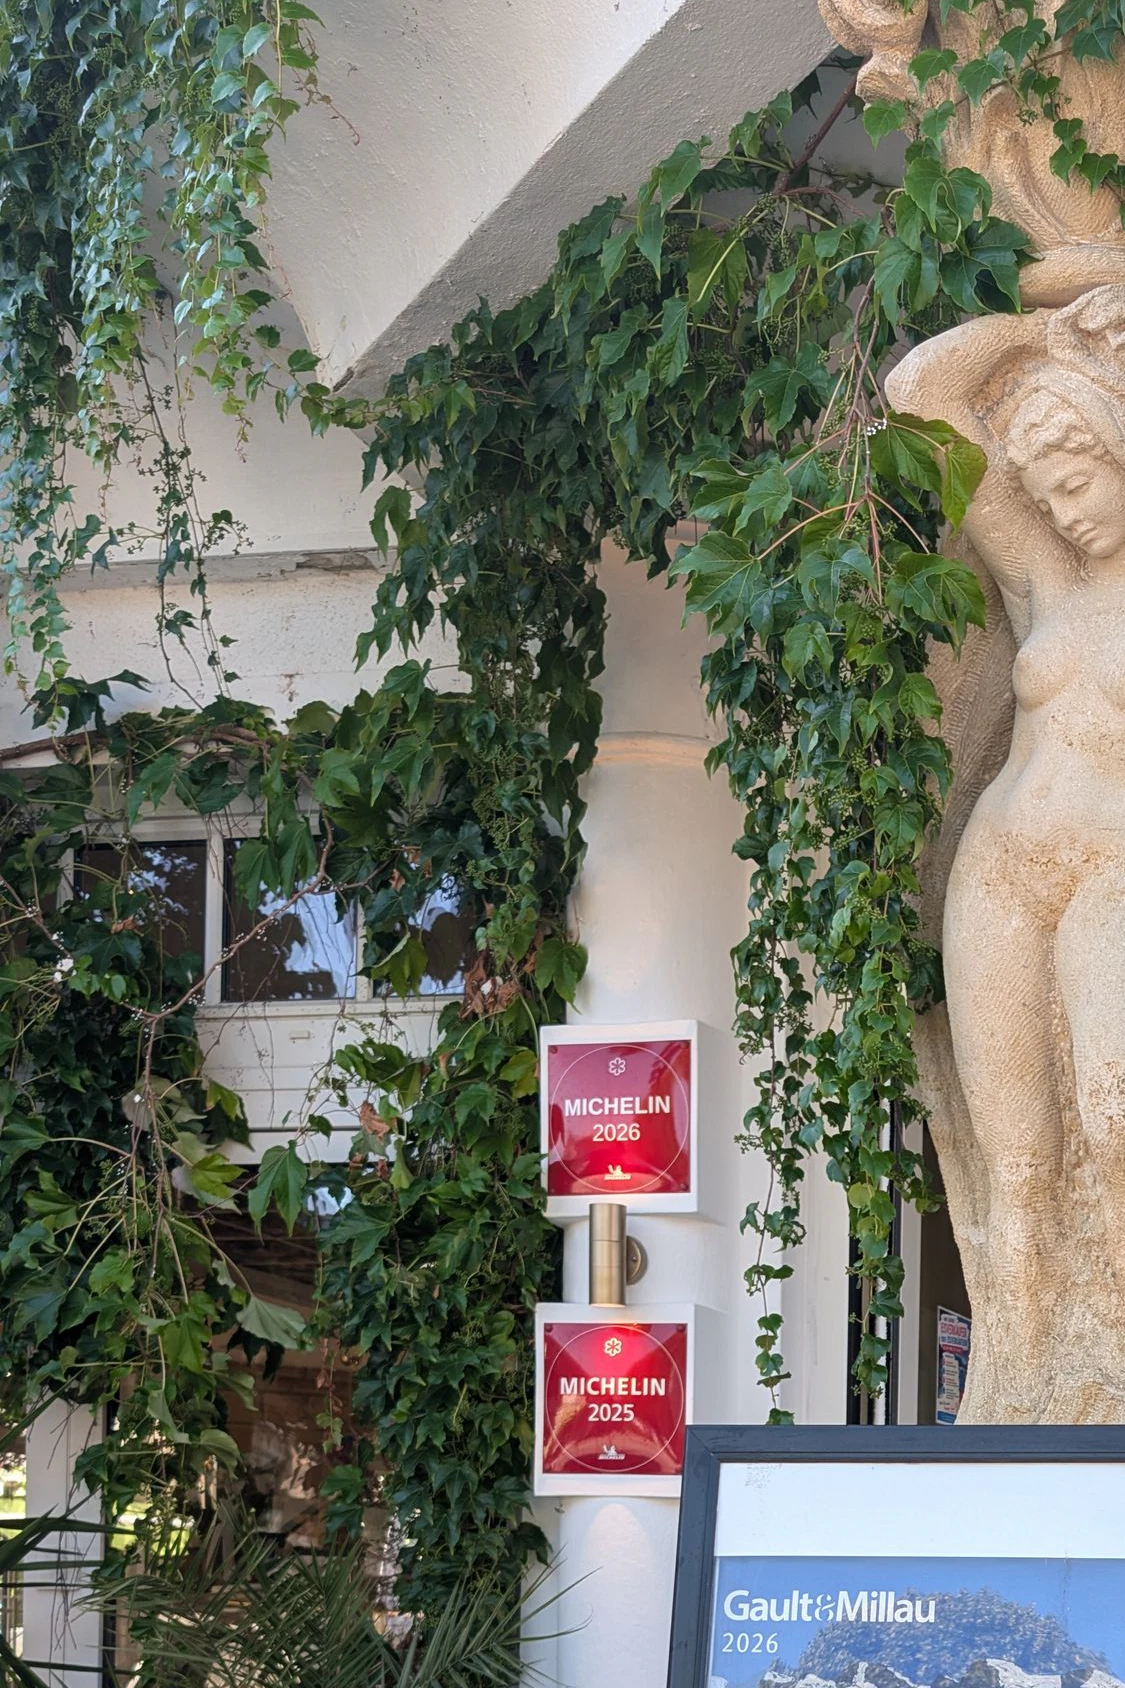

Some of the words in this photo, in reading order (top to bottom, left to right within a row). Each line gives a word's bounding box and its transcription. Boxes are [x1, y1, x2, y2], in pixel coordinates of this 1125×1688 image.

[565, 1095, 671, 1117] MICHELIN
[592, 1124, 641, 1142] 2026
[559, 1376, 666, 1397] MICHELIN
[588, 1403, 635, 1422] 2025
[723, 1589, 936, 1624] Gault&Millau
[722, 1632, 778, 1654] 2026
